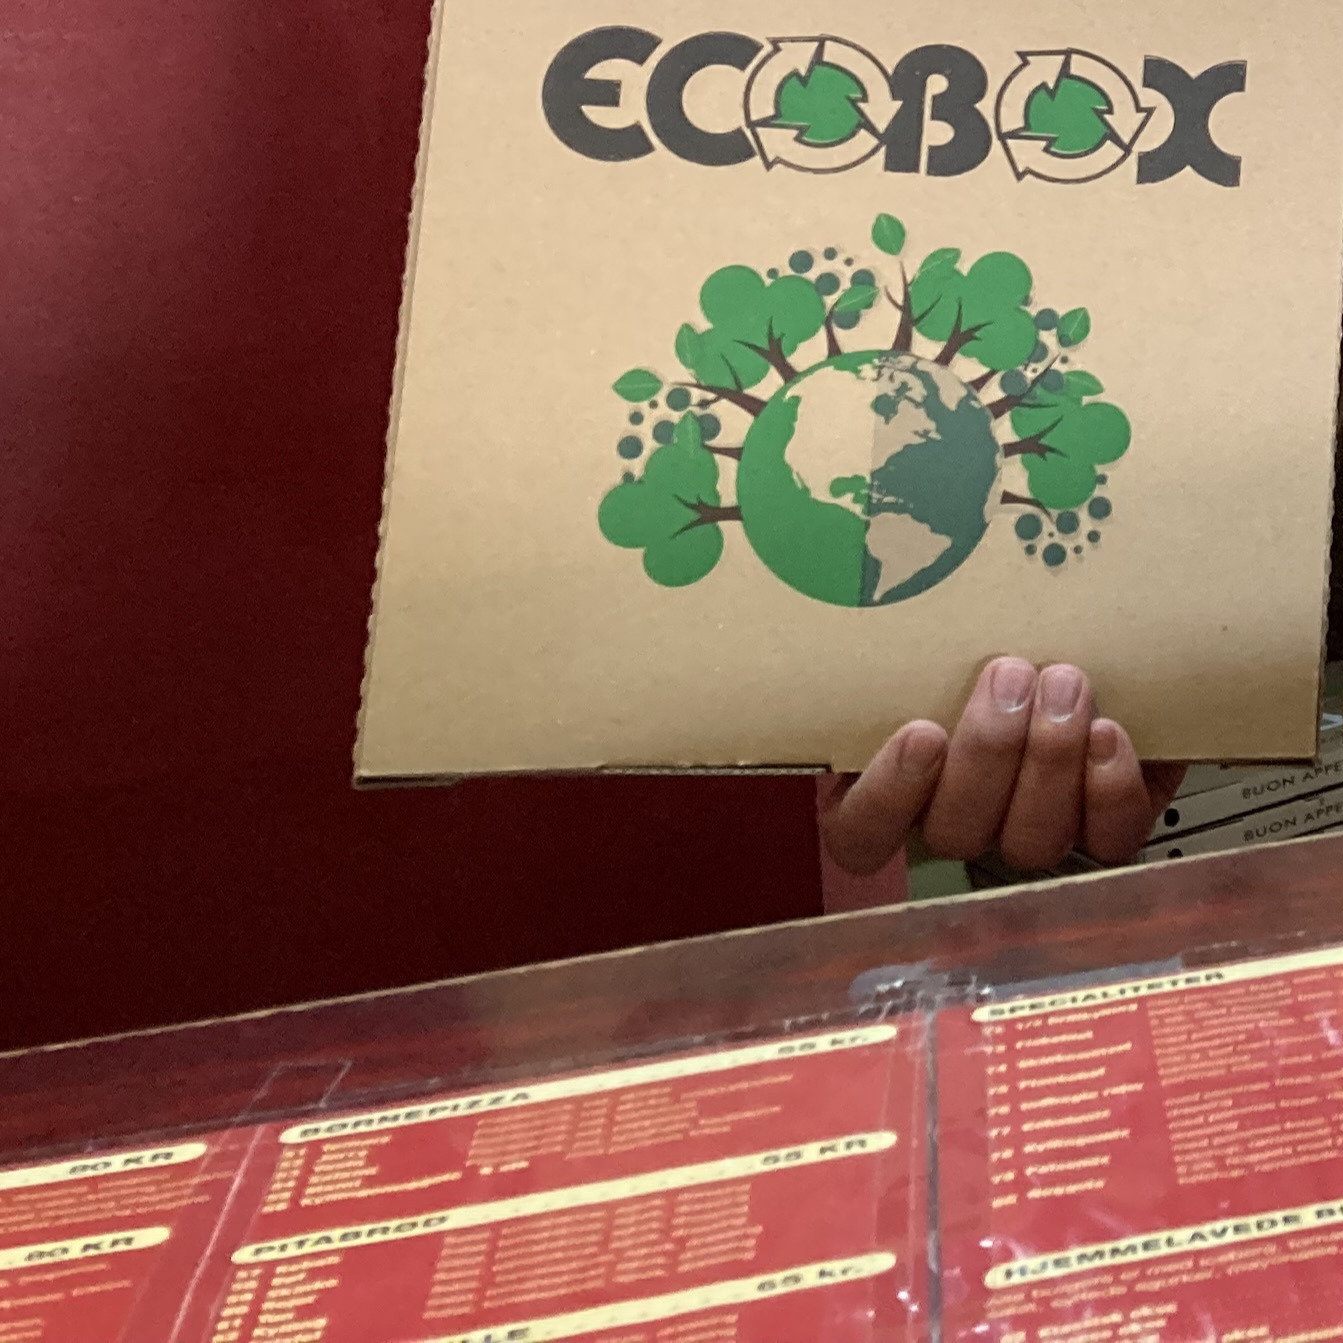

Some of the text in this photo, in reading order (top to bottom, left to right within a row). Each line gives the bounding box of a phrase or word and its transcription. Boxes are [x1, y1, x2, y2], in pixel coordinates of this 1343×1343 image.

[540, 24, 1248, 188] ECOBOX
[1241, 774, 1296, 801] BUON
[1243, 816, 1298, 843] BUON
[988, 970, 1225, 1017] SPECIALITETER
[252, 1214, 451, 1257] PITABRØD
[1002, 1211, 1303, 1282] HJEMMELAVEDE
